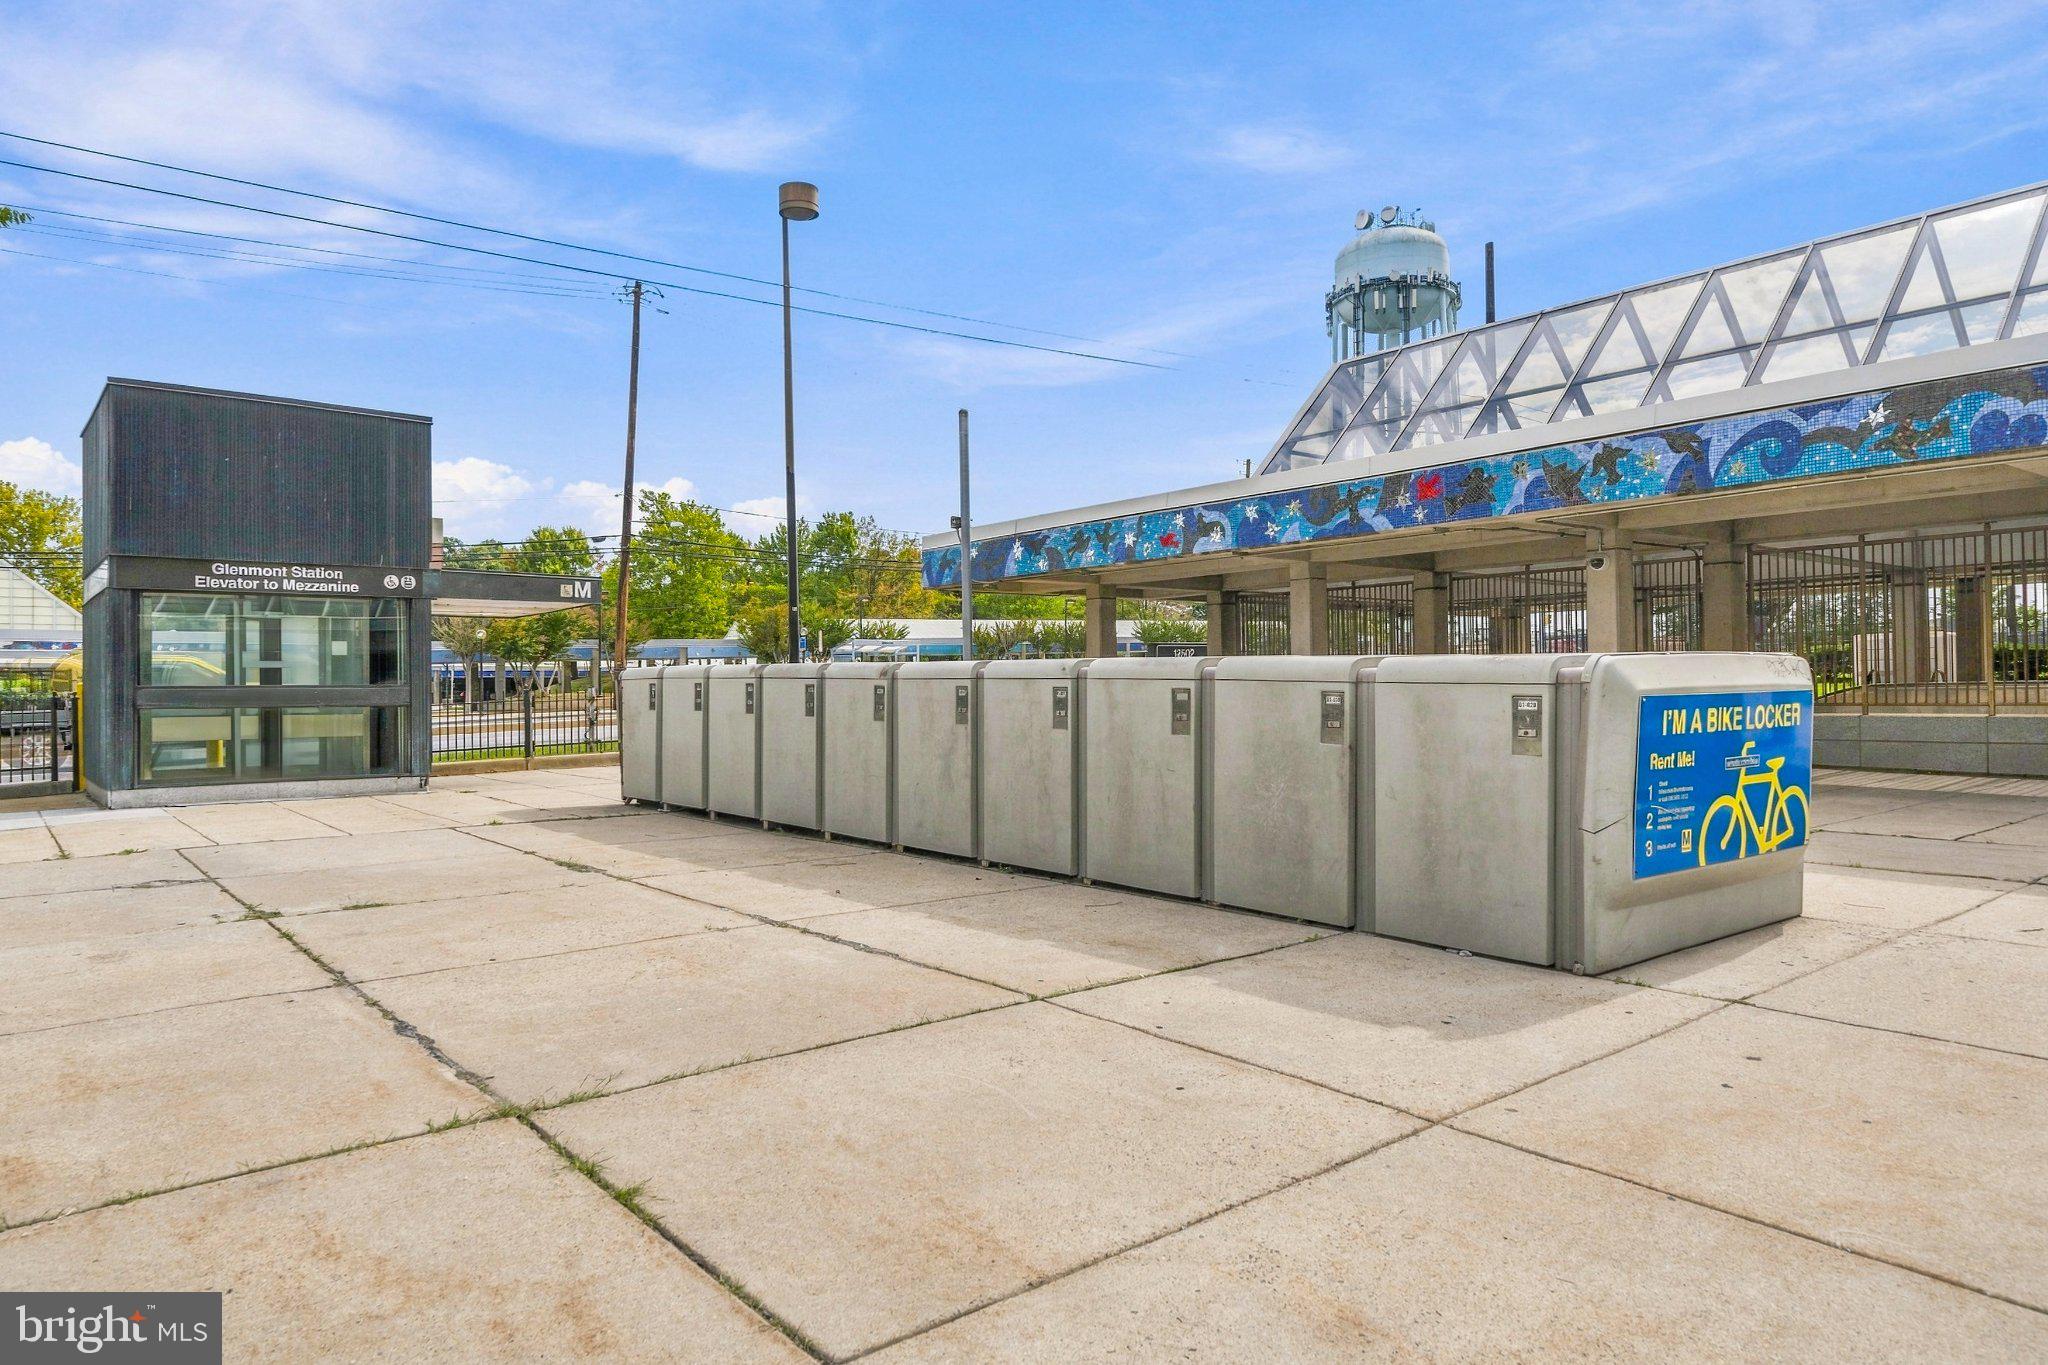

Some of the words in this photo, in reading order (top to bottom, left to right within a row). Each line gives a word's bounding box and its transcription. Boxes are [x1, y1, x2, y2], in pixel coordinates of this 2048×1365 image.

[211, 562, 287, 578] Glenmont
[290, 565, 343, 580] Station
[194, 575, 260, 590] Elevator
[263, 578, 279, 590] to
[282, 578, 360, 593] Mezzanine
[574, 581, 592, 598] M
[1662, 708, 1686, 736] I'M
[1690, 707, 1703, 734] A
[1706, 706, 1743, 733] BIKE
[1745, 702, 1801, 730] LOCKER
[1649, 752, 1675, 770] Rent
[1677, 750, 1696, 768] Me!
[1647, 784, 1653, 801] 1
[1645, 812, 1654, 830] 2
[1645, 840, 1653, 857] 3
